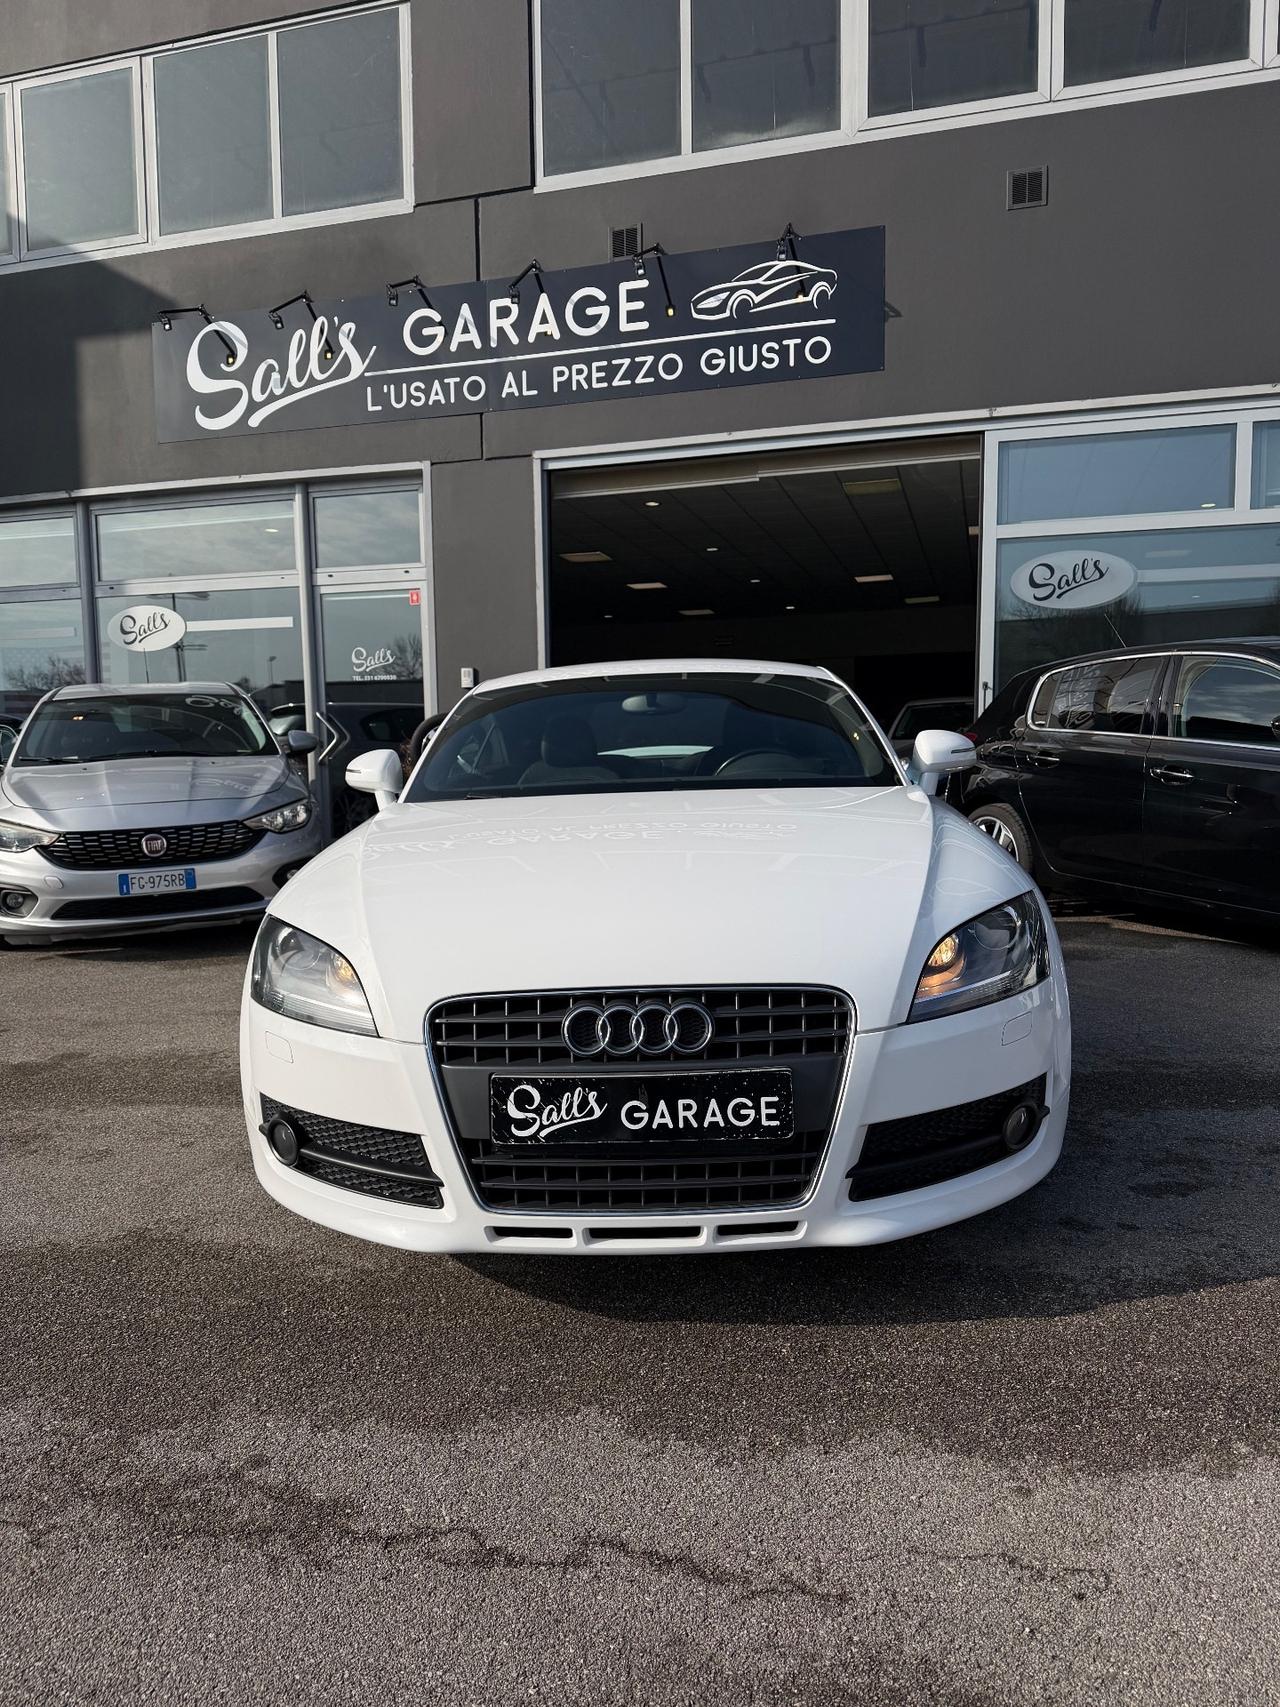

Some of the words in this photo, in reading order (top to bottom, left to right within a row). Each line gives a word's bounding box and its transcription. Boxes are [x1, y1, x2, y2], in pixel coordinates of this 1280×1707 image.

[186, 315, 377, 431] Sall's
[402, 278, 650, 356] GARAGE
[366, 375, 486, 412] L'USATO
[501, 369, 538, 398] AL
[553, 352, 683, 393] PREZZO
[700, 335, 832, 376] GIUSTO
[1028, 558, 1109, 602] Sall's
[120, 611, 171, 645] Sall's
[351, 647, 396, 672] Sall's
[146, 839, 162, 851] FIAT
[506, 1084, 608, 1138] Sall's
[620, 1096, 780, 1130] GARAGE
